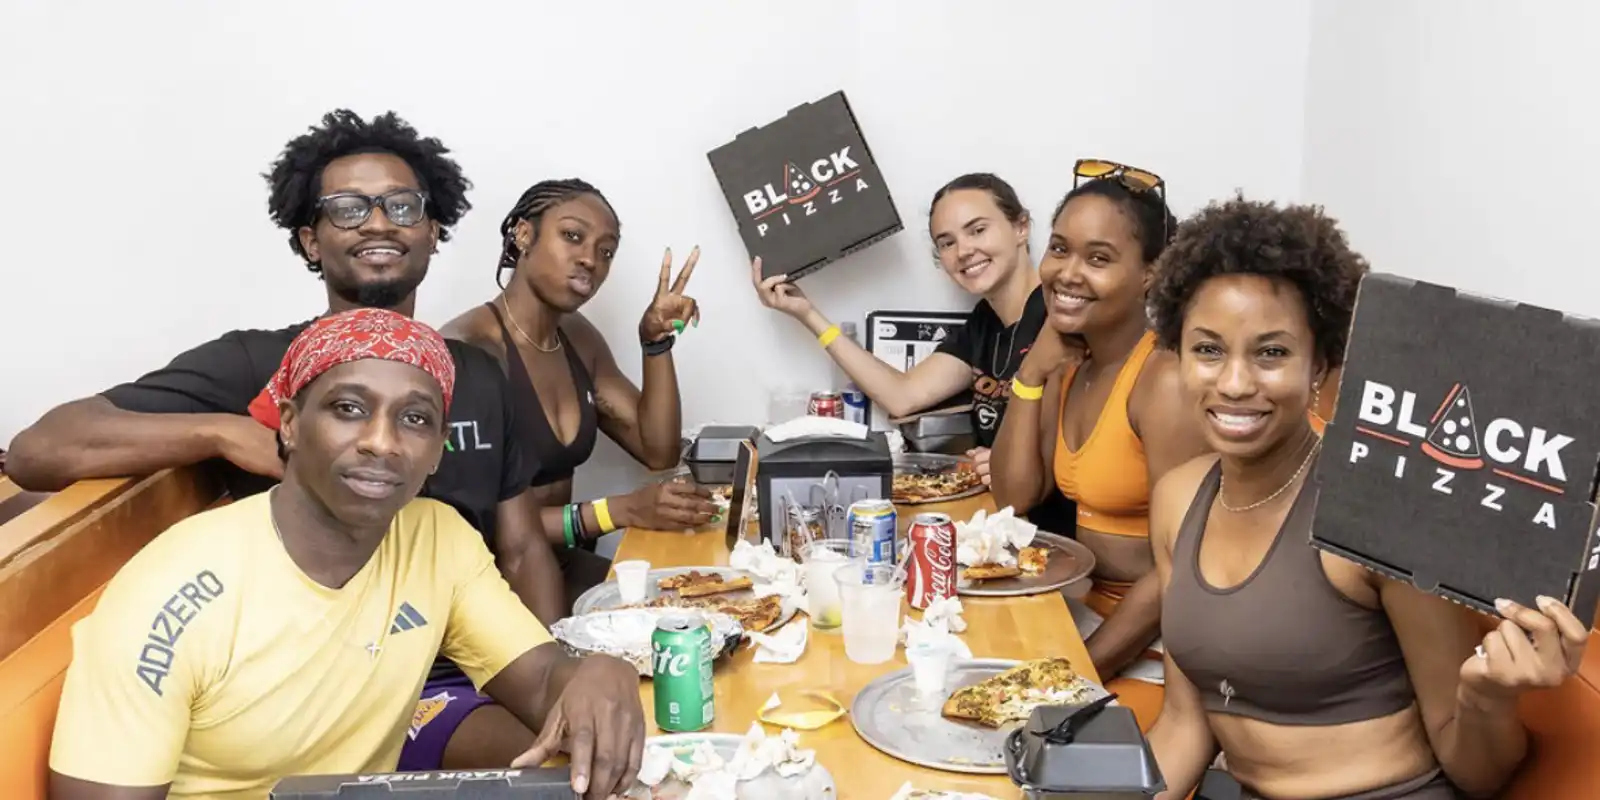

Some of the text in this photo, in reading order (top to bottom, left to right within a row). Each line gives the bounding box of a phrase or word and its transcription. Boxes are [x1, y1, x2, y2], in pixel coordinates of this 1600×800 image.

[757, 178, 868, 237] PIZZA
[445, 421, 492, 451] TL
[1349, 441, 1556, 530] PIZZA
[924, 525, 952, 606] oca-Cola
[136, 569, 224, 697] ADIZERO
